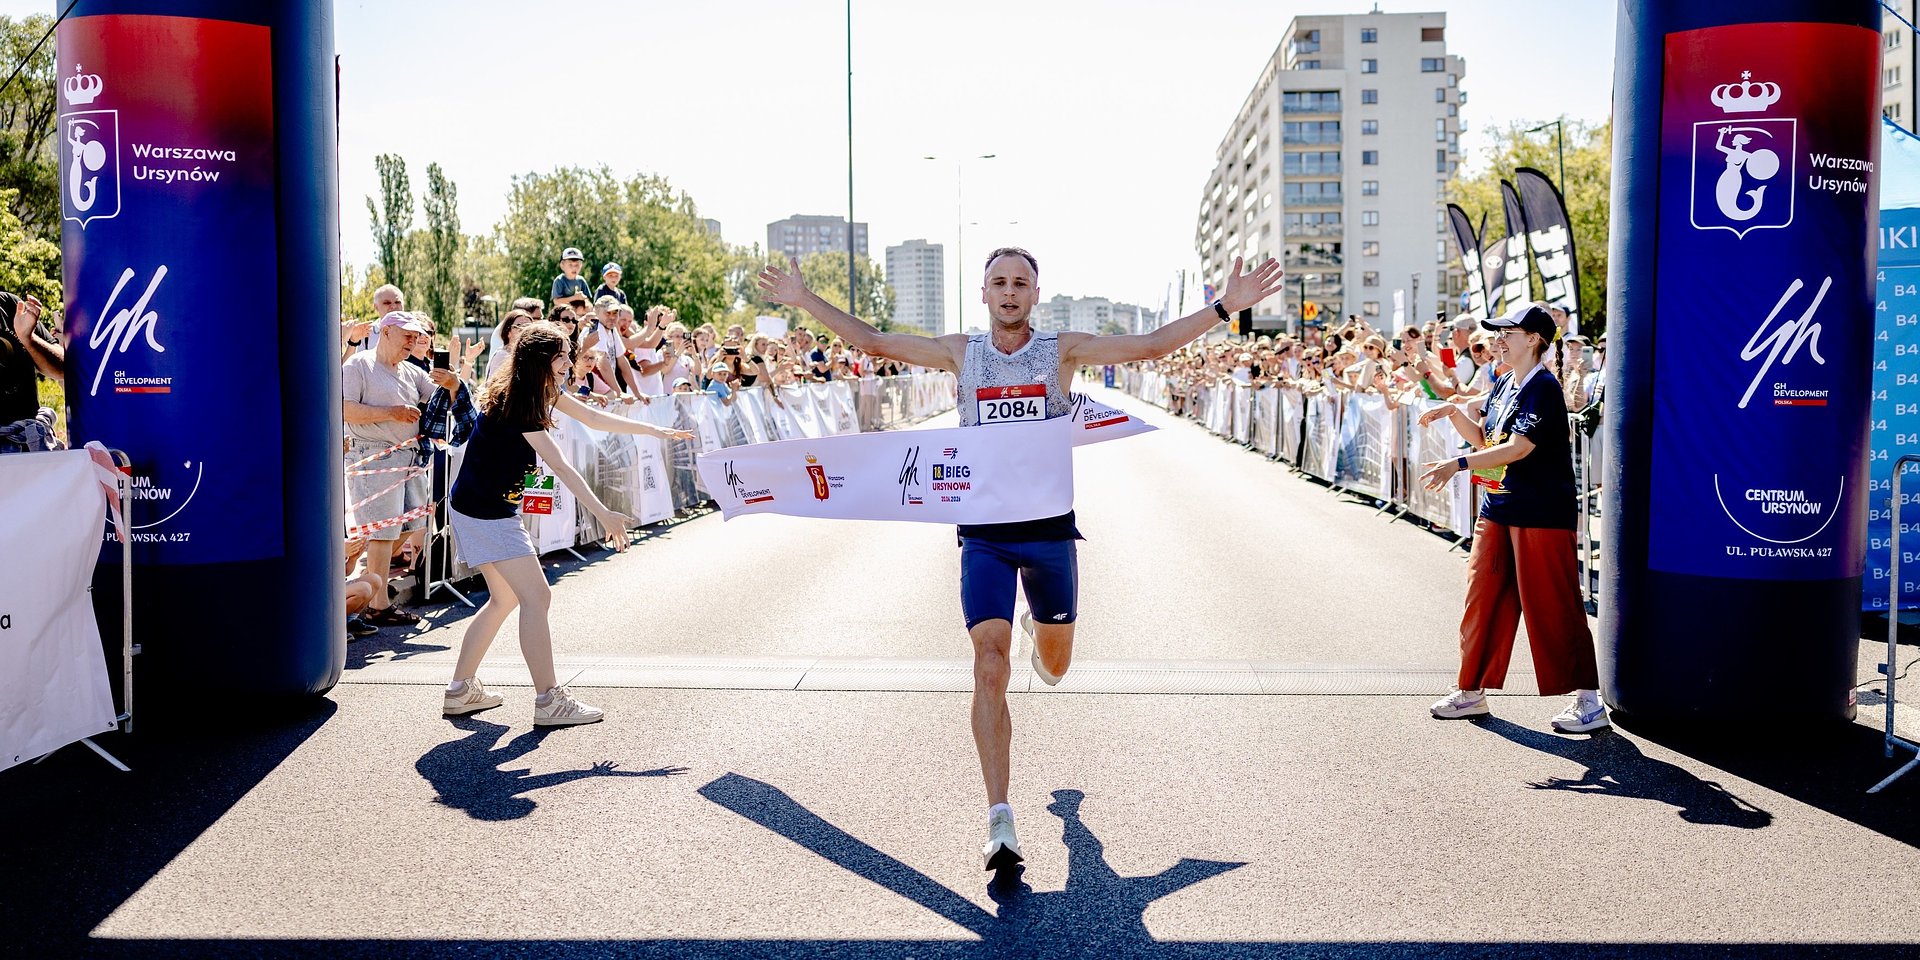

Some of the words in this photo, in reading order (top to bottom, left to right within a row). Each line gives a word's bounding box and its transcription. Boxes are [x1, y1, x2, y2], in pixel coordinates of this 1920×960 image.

[131, 143, 236, 162] Warszawa
[1809, 152, 1874, 173] Warszawa
[133, 165, 220, 184] Ursynów
[1809, 175, 1868, 194] Ursynów
[1894, 284, 1917, 297] B4
[1896, 314, 1918, 327] B4
[1895, 344, 1919, 356] B4
[1873, 360, 1888, 371] 4
[114, 377, 172, 385] DEVELOPMENT
[1896, 373, 1919, 386] B4
[1773, 382, 1787, 390] GH
[1773, 389, 1829, 398] DEVELOPMENT
[986, 400, 1039, 420] 2084
[1083, 408, 1095, 416] GH
[1895, 403, 1919, 416] B4
[1896, 433, 1918, 445] B4
[946, 465, 971, 478] BIEG
[932, 482, 971, 491] URSYNOWA
[1869, 479, 1891, 491] B4
[1745, 489, 1805, 502] CENTRUM
[1900, 493, 1920, 505] B4
[1761, 499, 1822, 515] URSYNÓW
[1869, 509, 1892, 521] B4
[1900, 523, 1920, 534] B4
[106, 533, 167, 542] PUWSKA
[169, 533, 191, 542] 427
[1871, 538, 1891, 550] B4
[1726, 545, 1747, 556] UL.
[1750, 547, 1815, 558] PUŁAWSKA
[1816, 547, 1833, 557] 427
